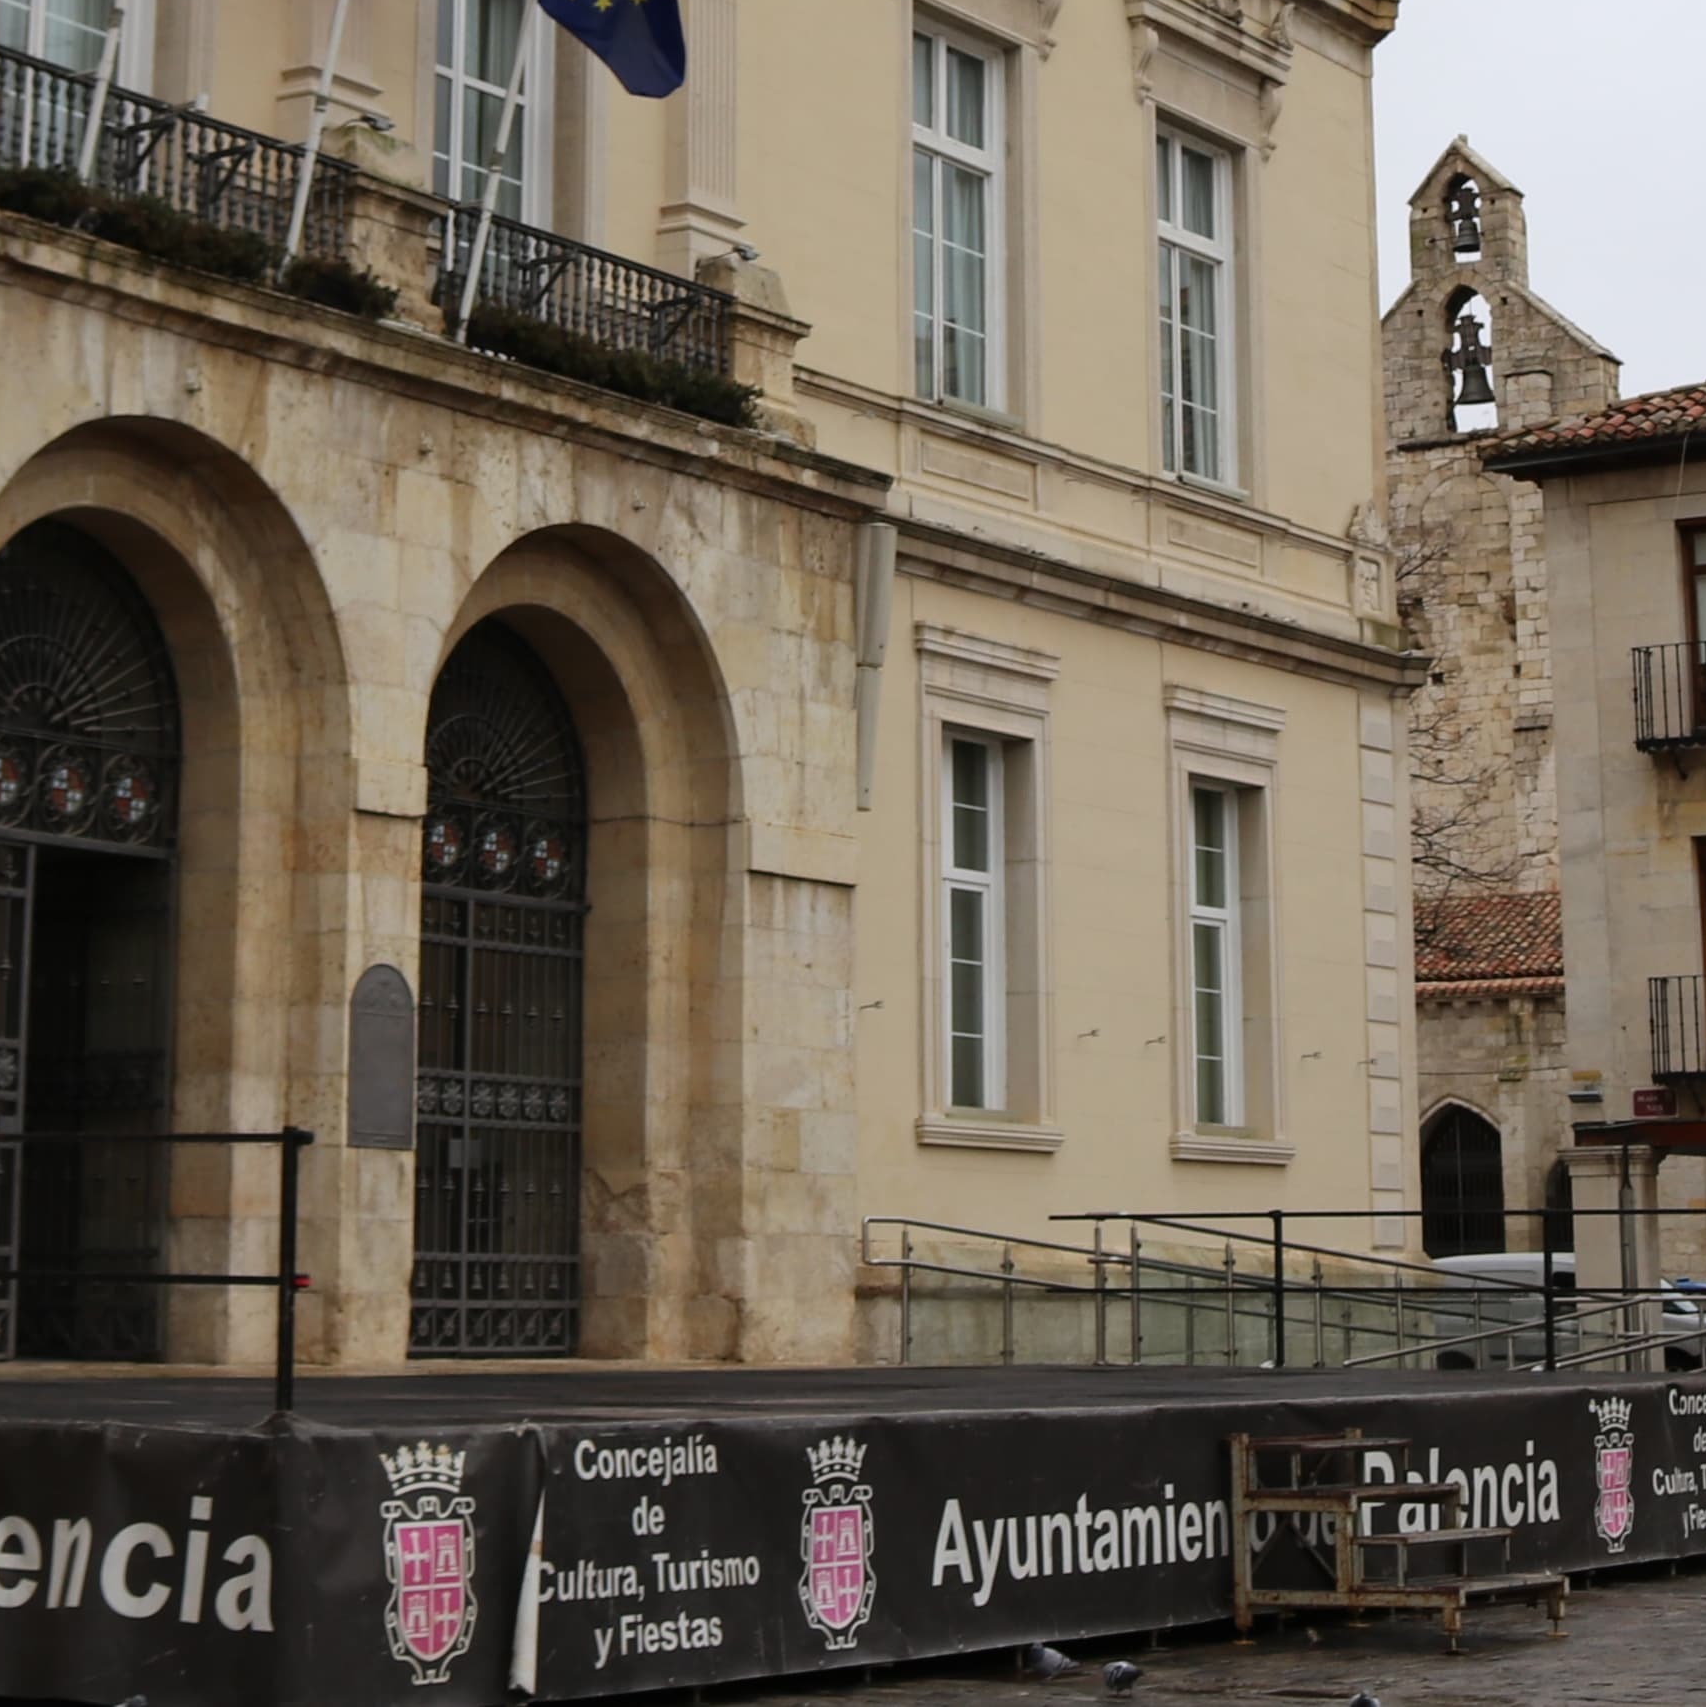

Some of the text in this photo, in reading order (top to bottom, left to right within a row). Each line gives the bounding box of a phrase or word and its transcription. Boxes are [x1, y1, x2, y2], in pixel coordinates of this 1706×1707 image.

[573, 1433, 719, 1486] Concejalía
[632, 1496, 666, 1537] de
[931, 1482, 1277, 1608] Ayuntamieno
[536, 1549, 762, 1605] Cultura, Turismo
[594, 1611, 724, 1670] y Fiestas
